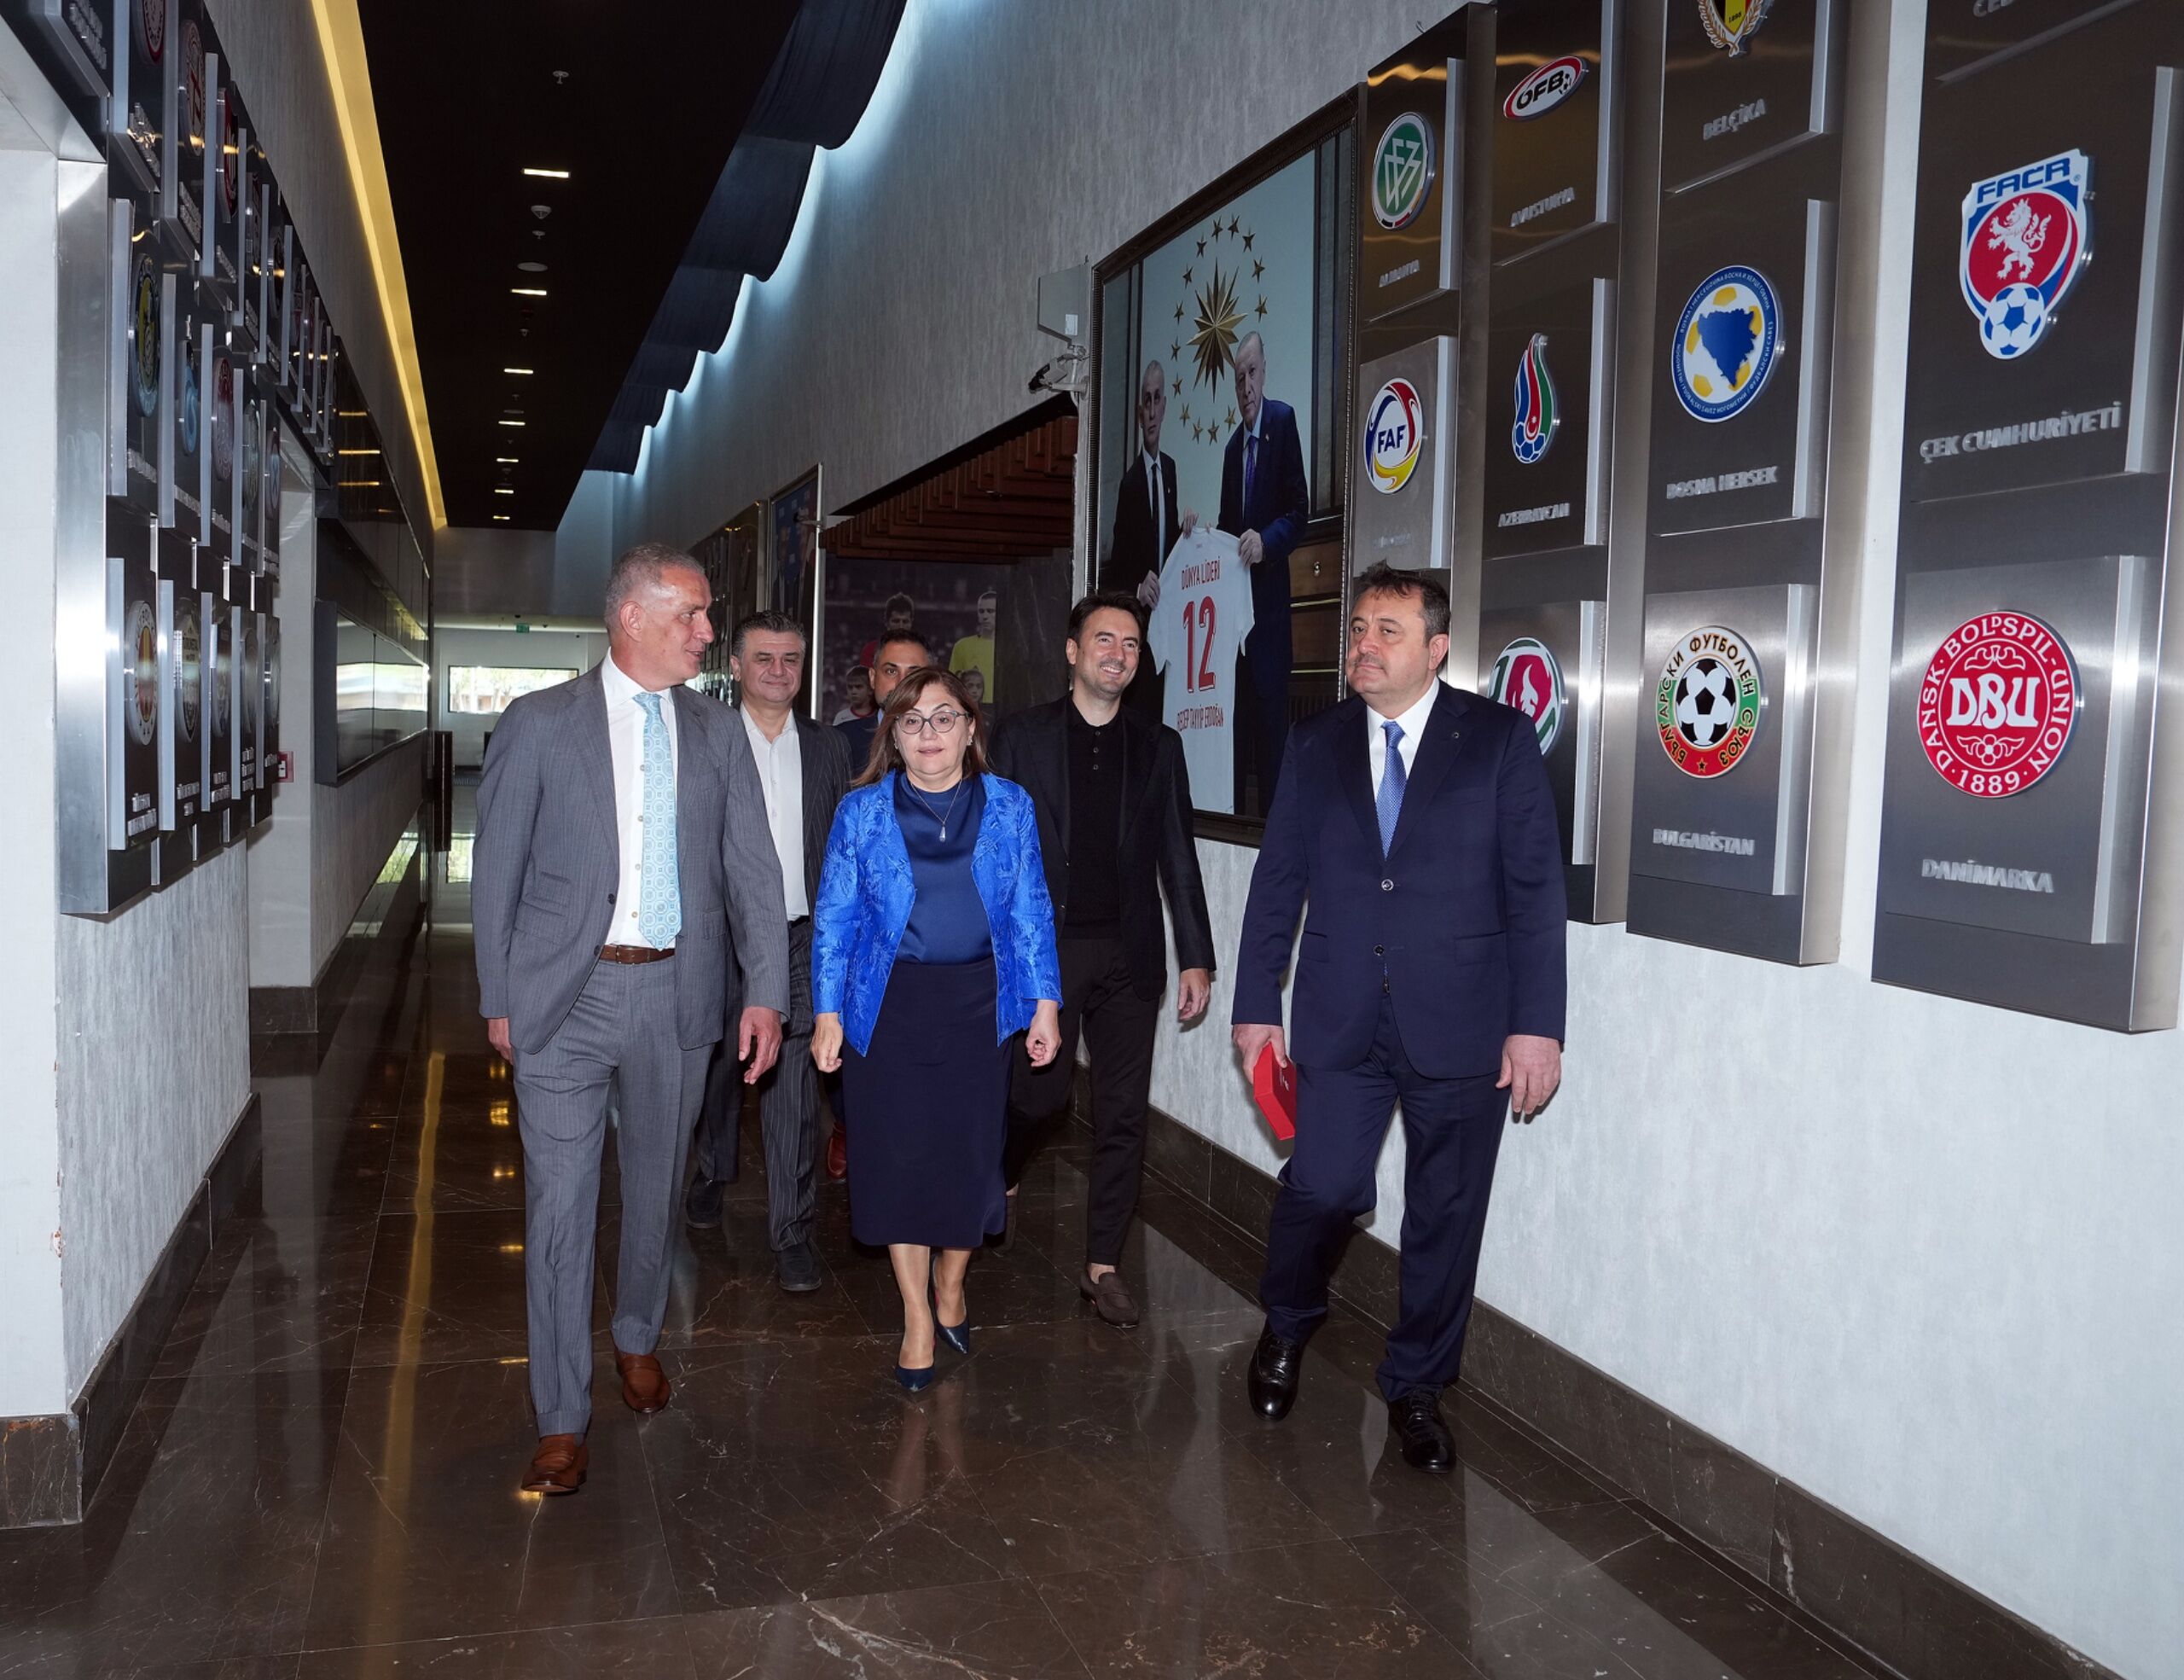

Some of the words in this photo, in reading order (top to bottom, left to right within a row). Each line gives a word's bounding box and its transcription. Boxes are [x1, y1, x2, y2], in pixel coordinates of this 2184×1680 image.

[1703, 98, 1766, 141] BELÇİKA
[1377, 424, 1406, 454] FAF
[1920, 434, 1962, 464] ÇEK
[1962, 401, 2123, 452] CUMHURİYETİ
[1666, 477, 1716, 499] BOSNA
[1182, 596, 1216, 693] 12
[1689, 634, 1756, 696] ФУТБОЛЕН
[1921, 664, 1954, 771] DANSK
[1946, 672, 2041, 730] DBU
[1718, 707, 1753, 765] СЪЮЗ
[1957, 770, 2020, 794] 1889
[1653, 828, 1755, 856] BULGARİSTAN
[1921, 858, 2054, 893] DANİMARKA
